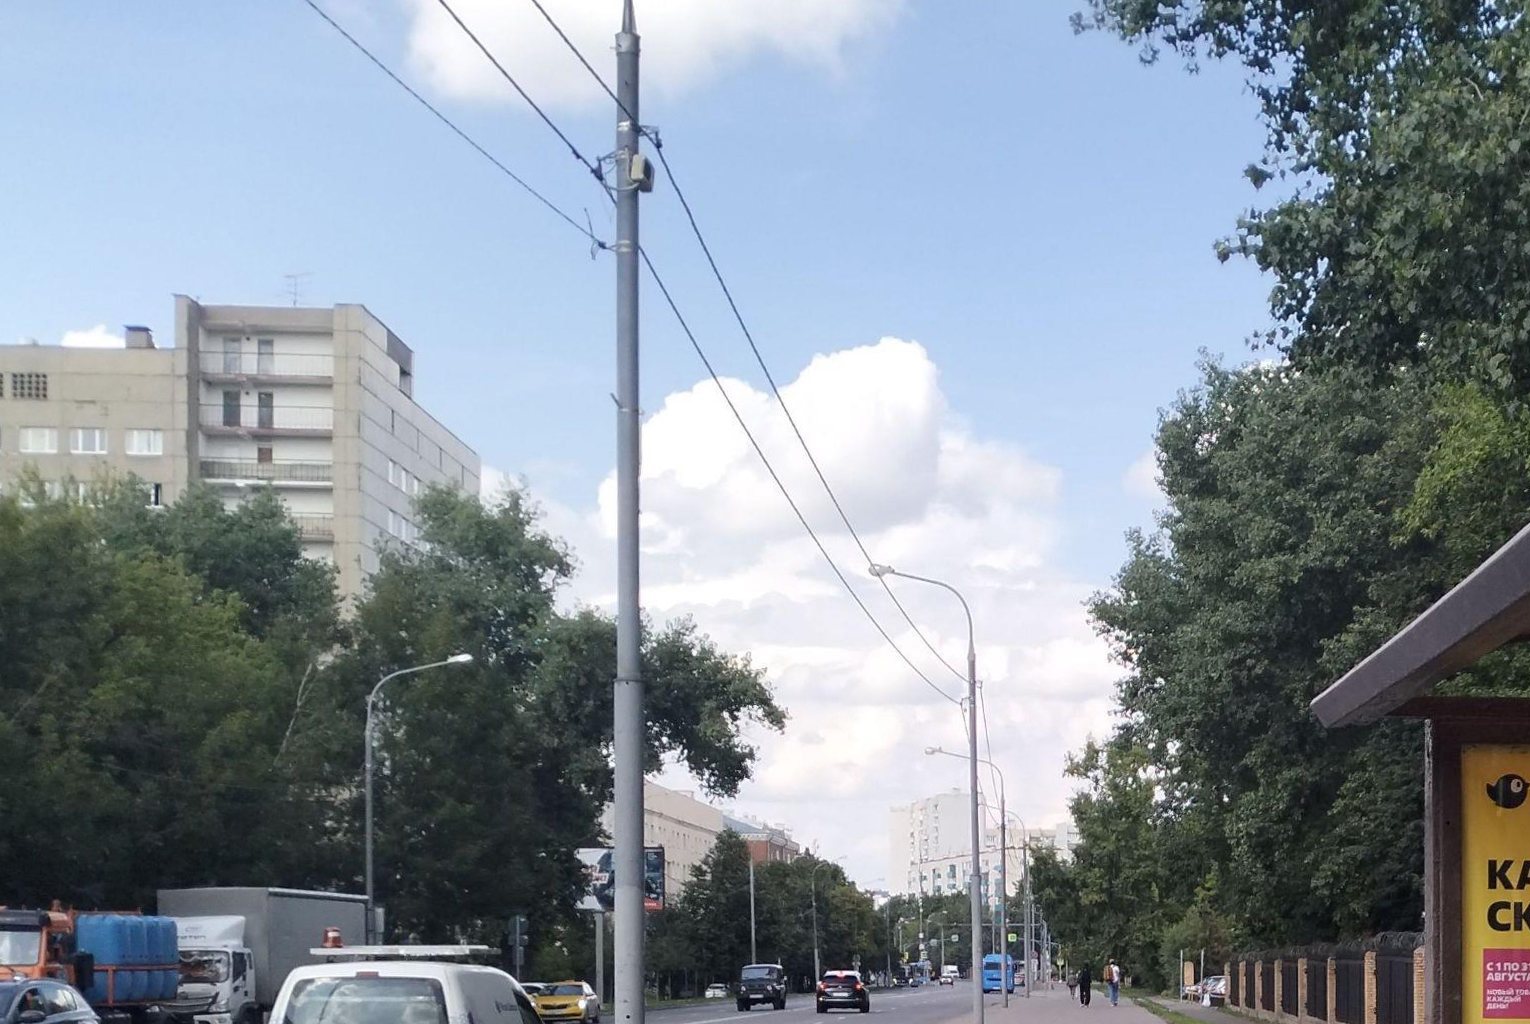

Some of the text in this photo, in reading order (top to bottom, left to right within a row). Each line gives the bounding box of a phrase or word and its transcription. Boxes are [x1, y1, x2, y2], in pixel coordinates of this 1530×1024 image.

[1486, 963, 1493, 971] С
[1496, 963, 1501, 971] 1
[1503, 963, 1519, 971] ПО
